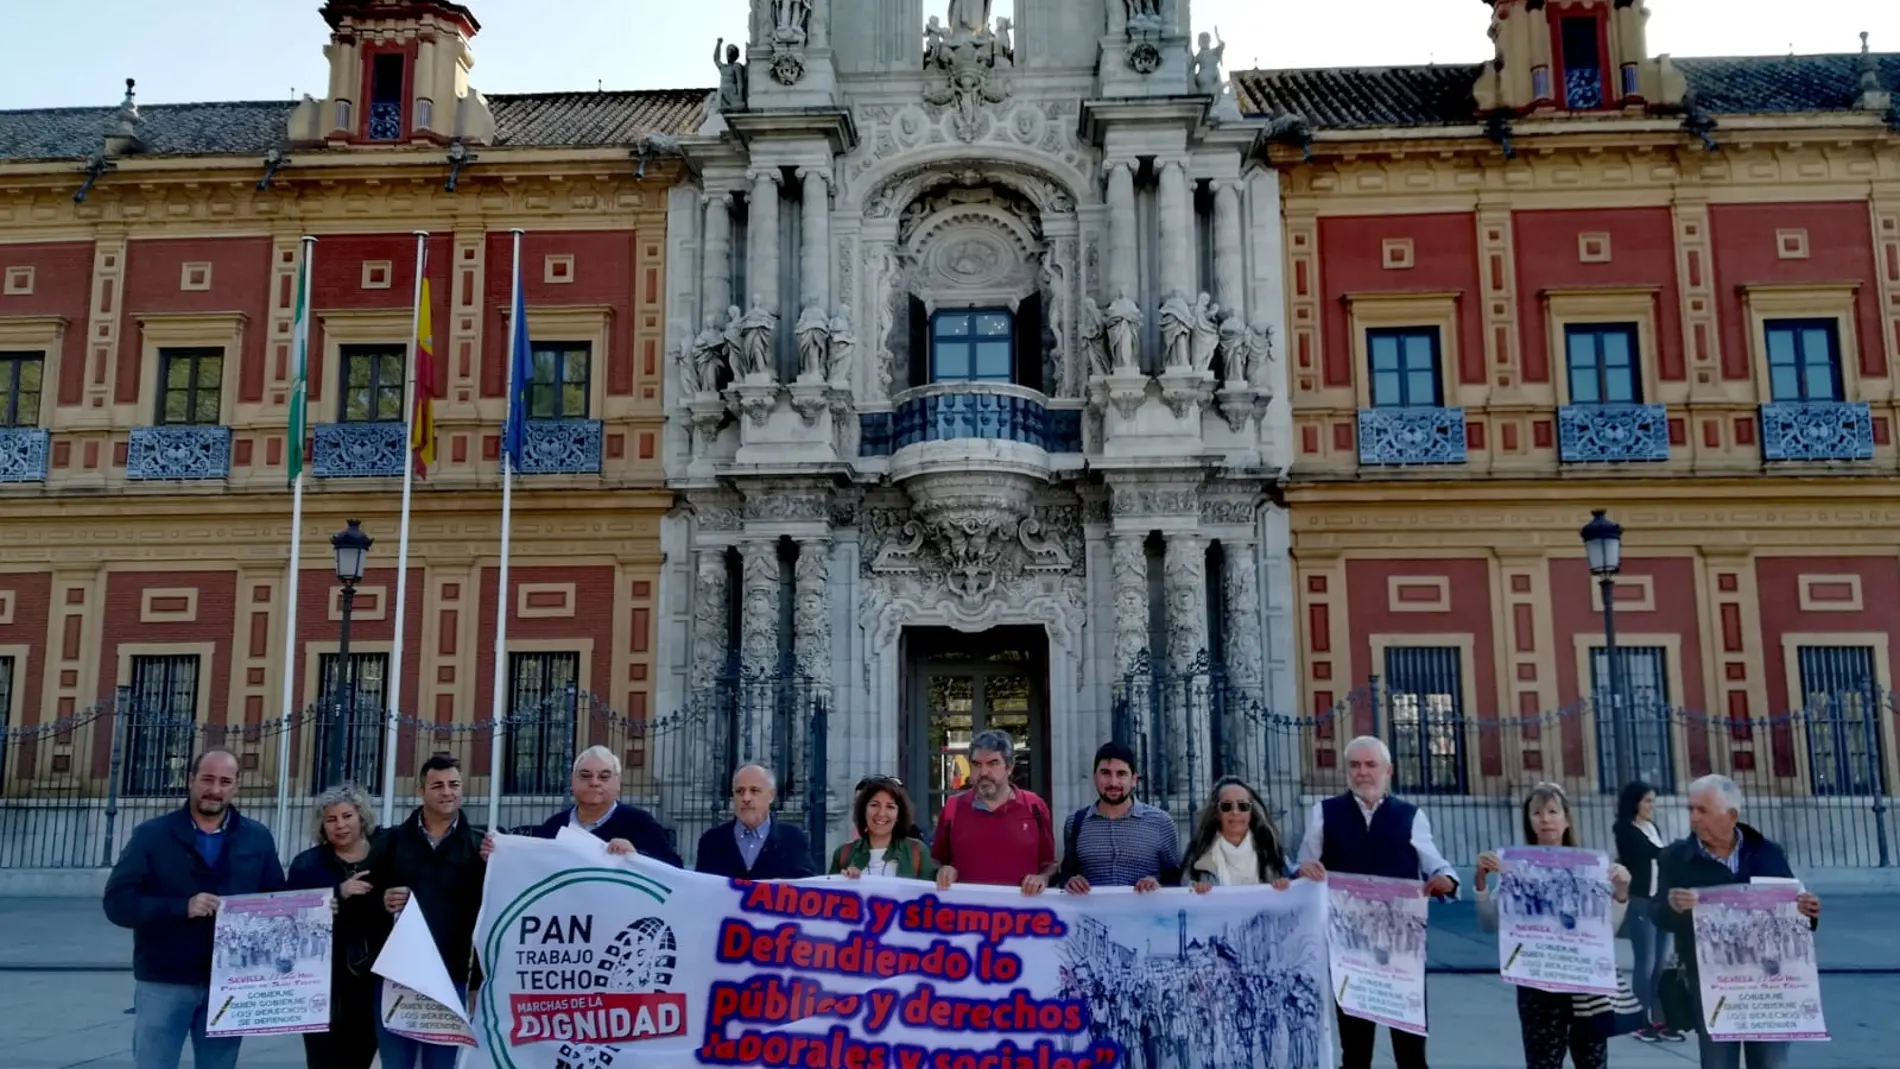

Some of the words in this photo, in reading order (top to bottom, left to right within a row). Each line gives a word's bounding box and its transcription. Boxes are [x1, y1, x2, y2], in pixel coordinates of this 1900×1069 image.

[519, 914, 593, 945] PAN
[871, 901, 894, 933] y
[904, 898, 1063, 943] siempre.
[515, 949, 593, 965] TRABAJO
[723, 924, 968, 979] Defendiendo
[980, 947, 1017, 980] lo
[516, 969, 592, 990] TECHO
[517, 997, 568, 1013] MARCHAS
[571, 996, 585, 1009] DE
[588, 995, 603, 1006] LA
[517, 1002, 681, 1040] DIGNIDAD
[869, 992, 894, 1029] y
[904, 989, 1081, 1030] derechos
